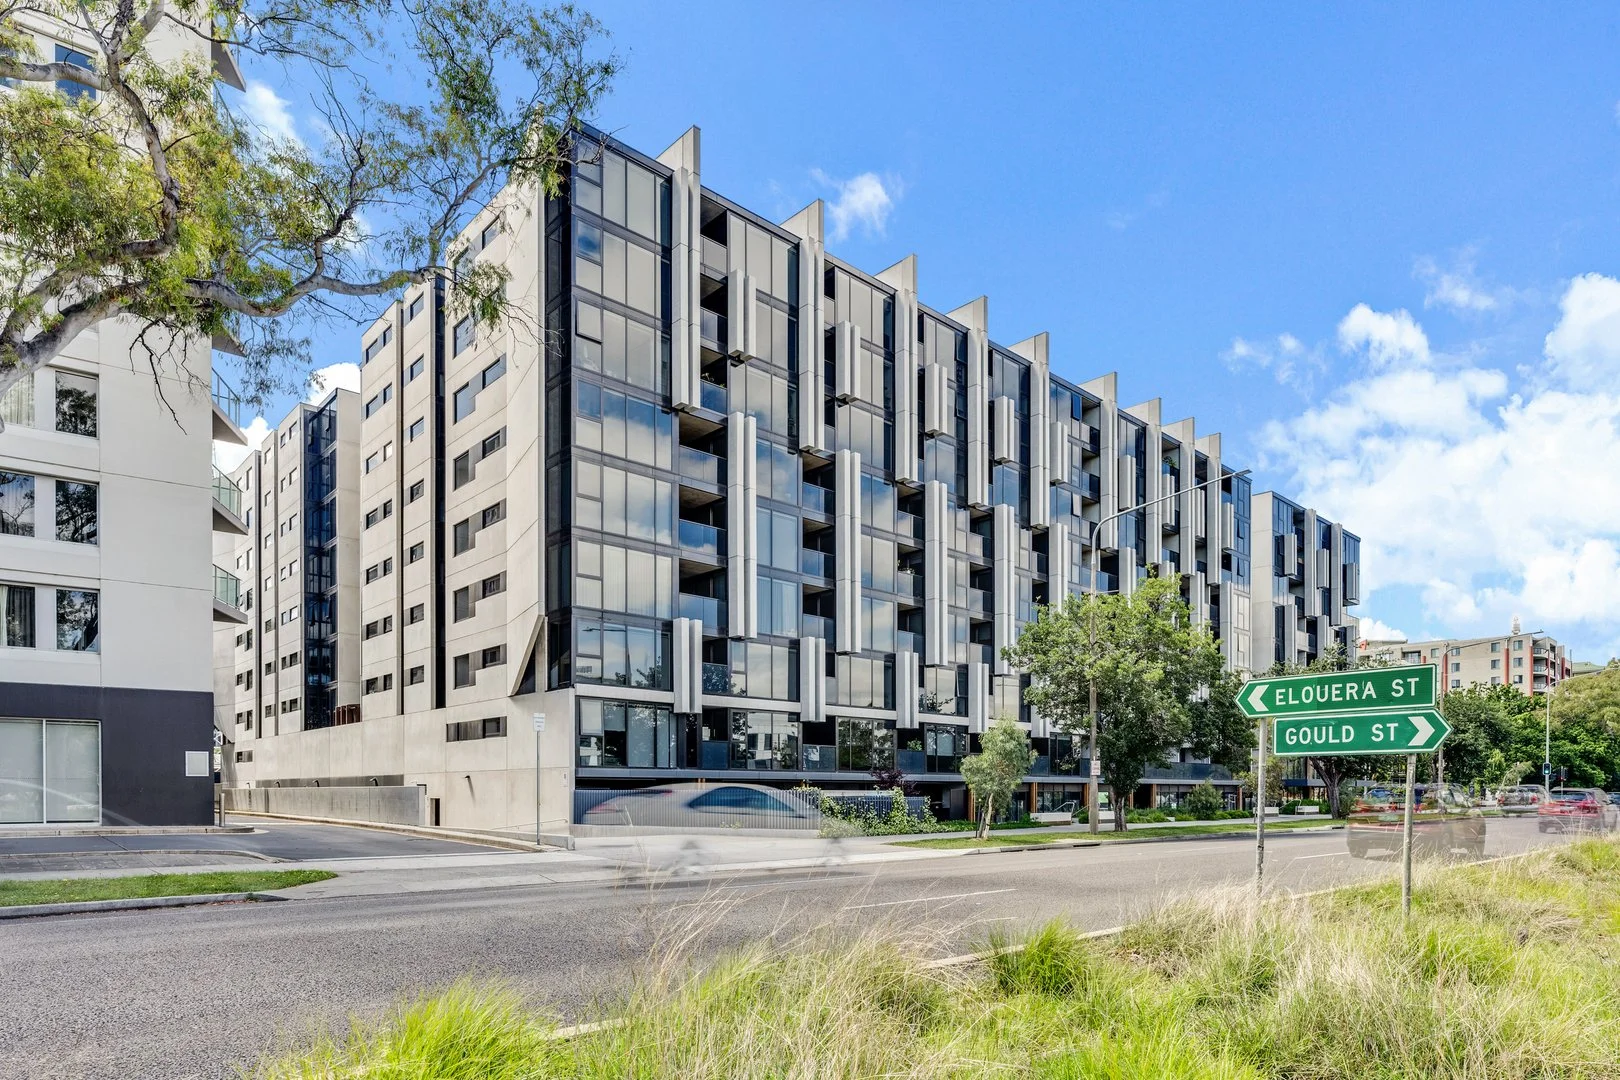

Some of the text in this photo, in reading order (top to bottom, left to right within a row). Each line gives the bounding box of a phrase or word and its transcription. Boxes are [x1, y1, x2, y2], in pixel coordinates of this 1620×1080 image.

[1275, 677, 1420, 706] ELOUERA ST
[1285, 722, 1399, 745] GOULD ST
